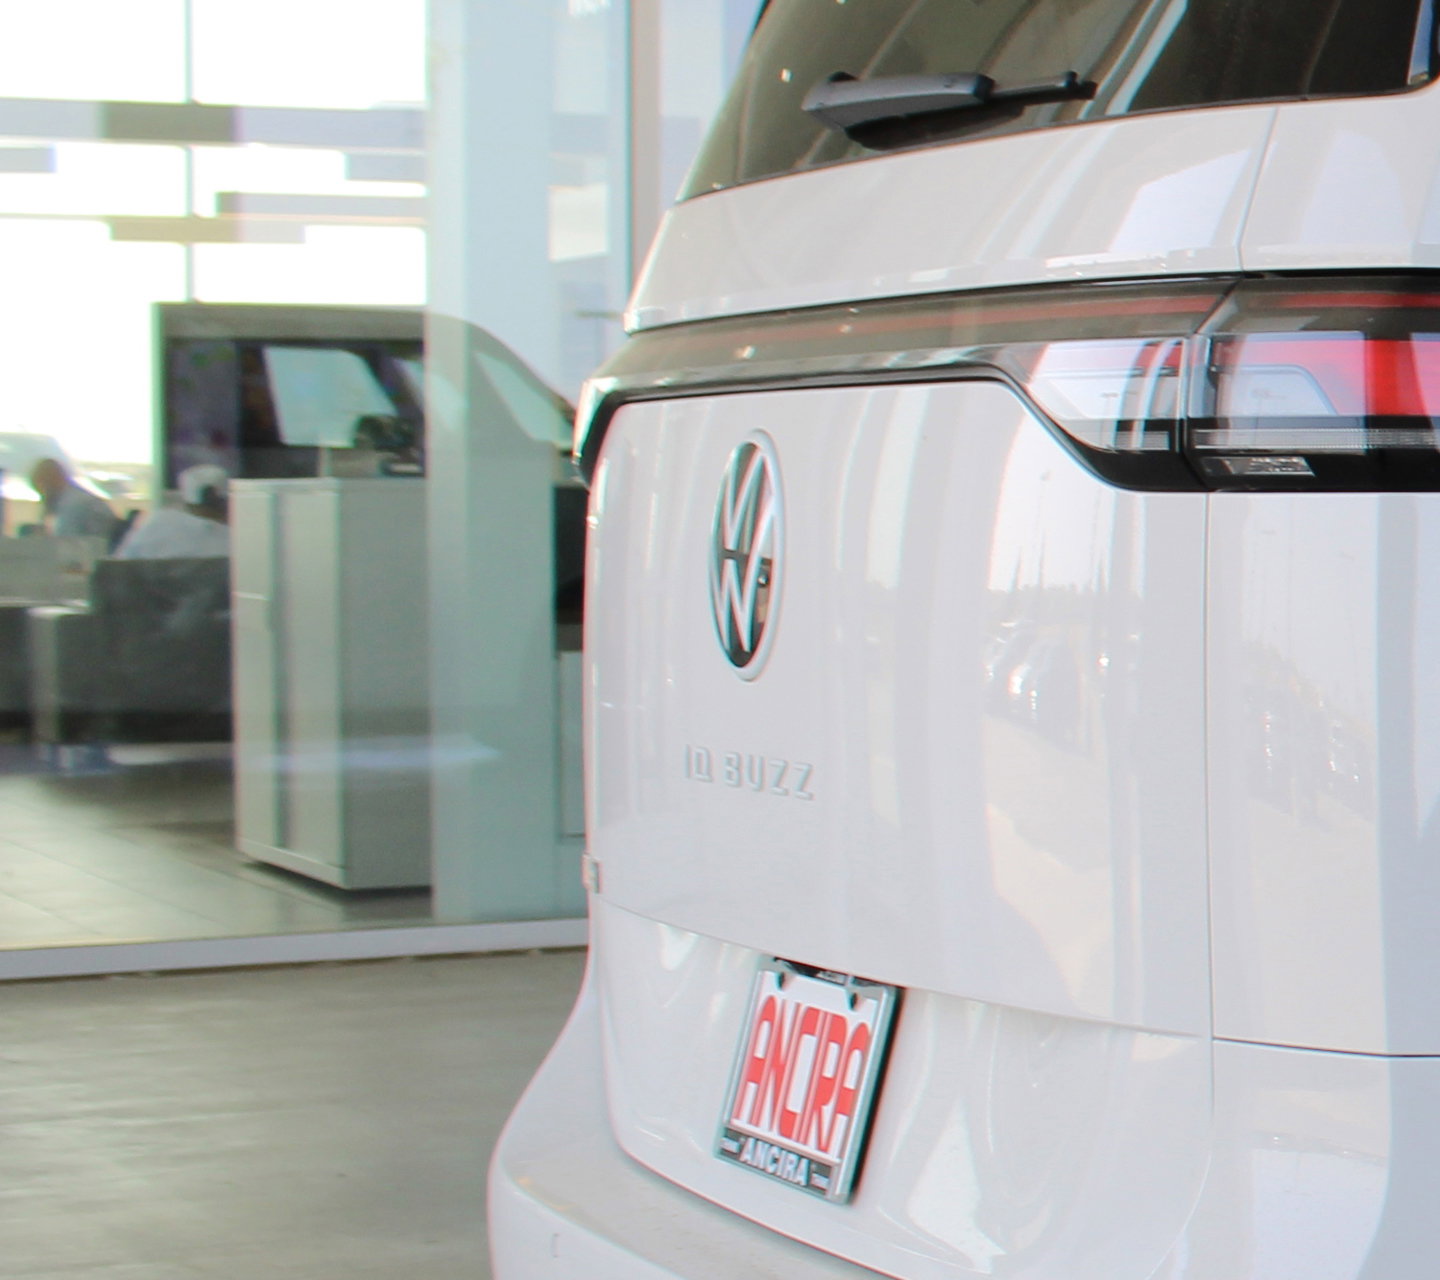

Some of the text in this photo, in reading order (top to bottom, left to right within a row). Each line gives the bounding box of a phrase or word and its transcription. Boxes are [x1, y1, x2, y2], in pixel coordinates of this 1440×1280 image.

[722, 751, 815, 800] BUZZ
[731, 995, 870, 1152] ANCIRA
[740, 1137, 810, 1186] ANCIRA
